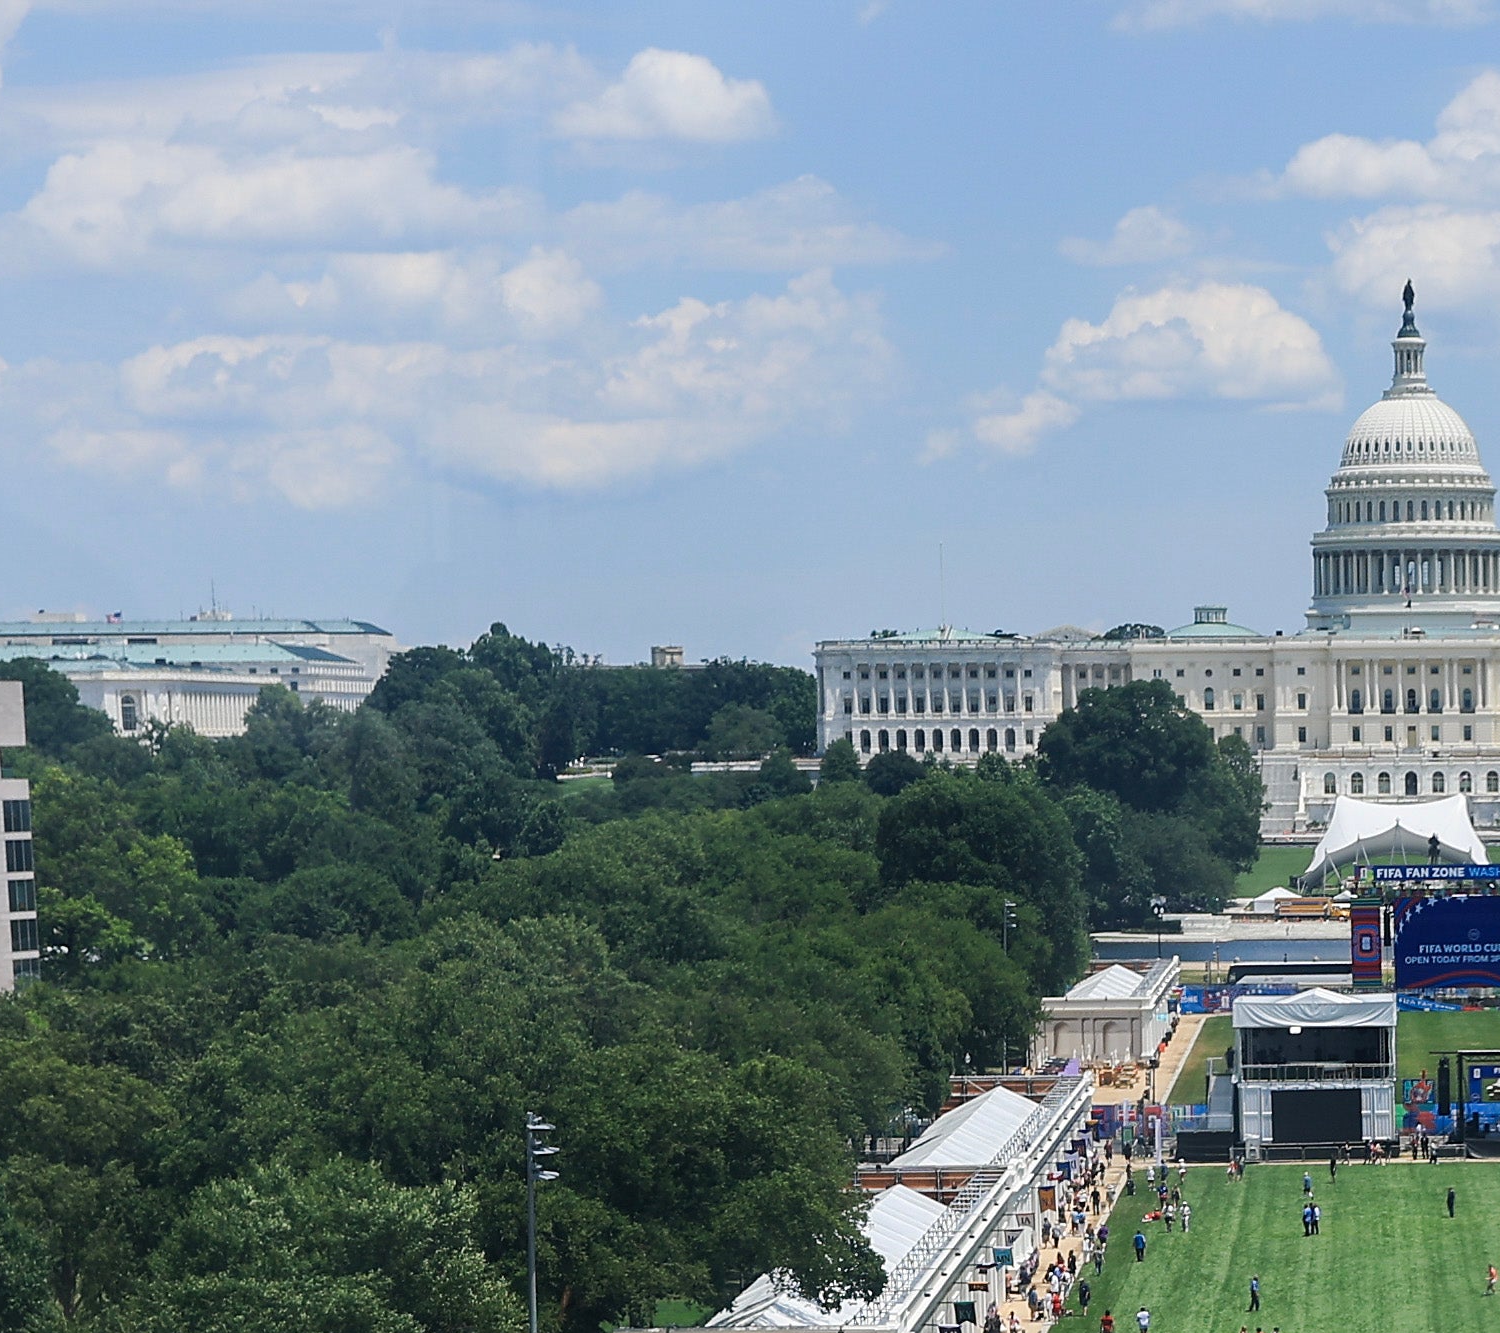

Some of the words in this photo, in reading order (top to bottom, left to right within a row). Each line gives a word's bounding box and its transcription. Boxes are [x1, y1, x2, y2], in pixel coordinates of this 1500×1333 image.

[1376, 867, 1403, 878] FIFA
[1406, 867, 1437, 878] FAN
[1438, 866, 1465, 878] ZONE
[1419, 944, 1442, 954] FIFA
[1443, 944, 1482, 953] WORLD
[1404, 955, 1430, 964] OPEN
[1431, 954, 1460, 963] TODAY
[1462, 954, 1489, 963] FROM
